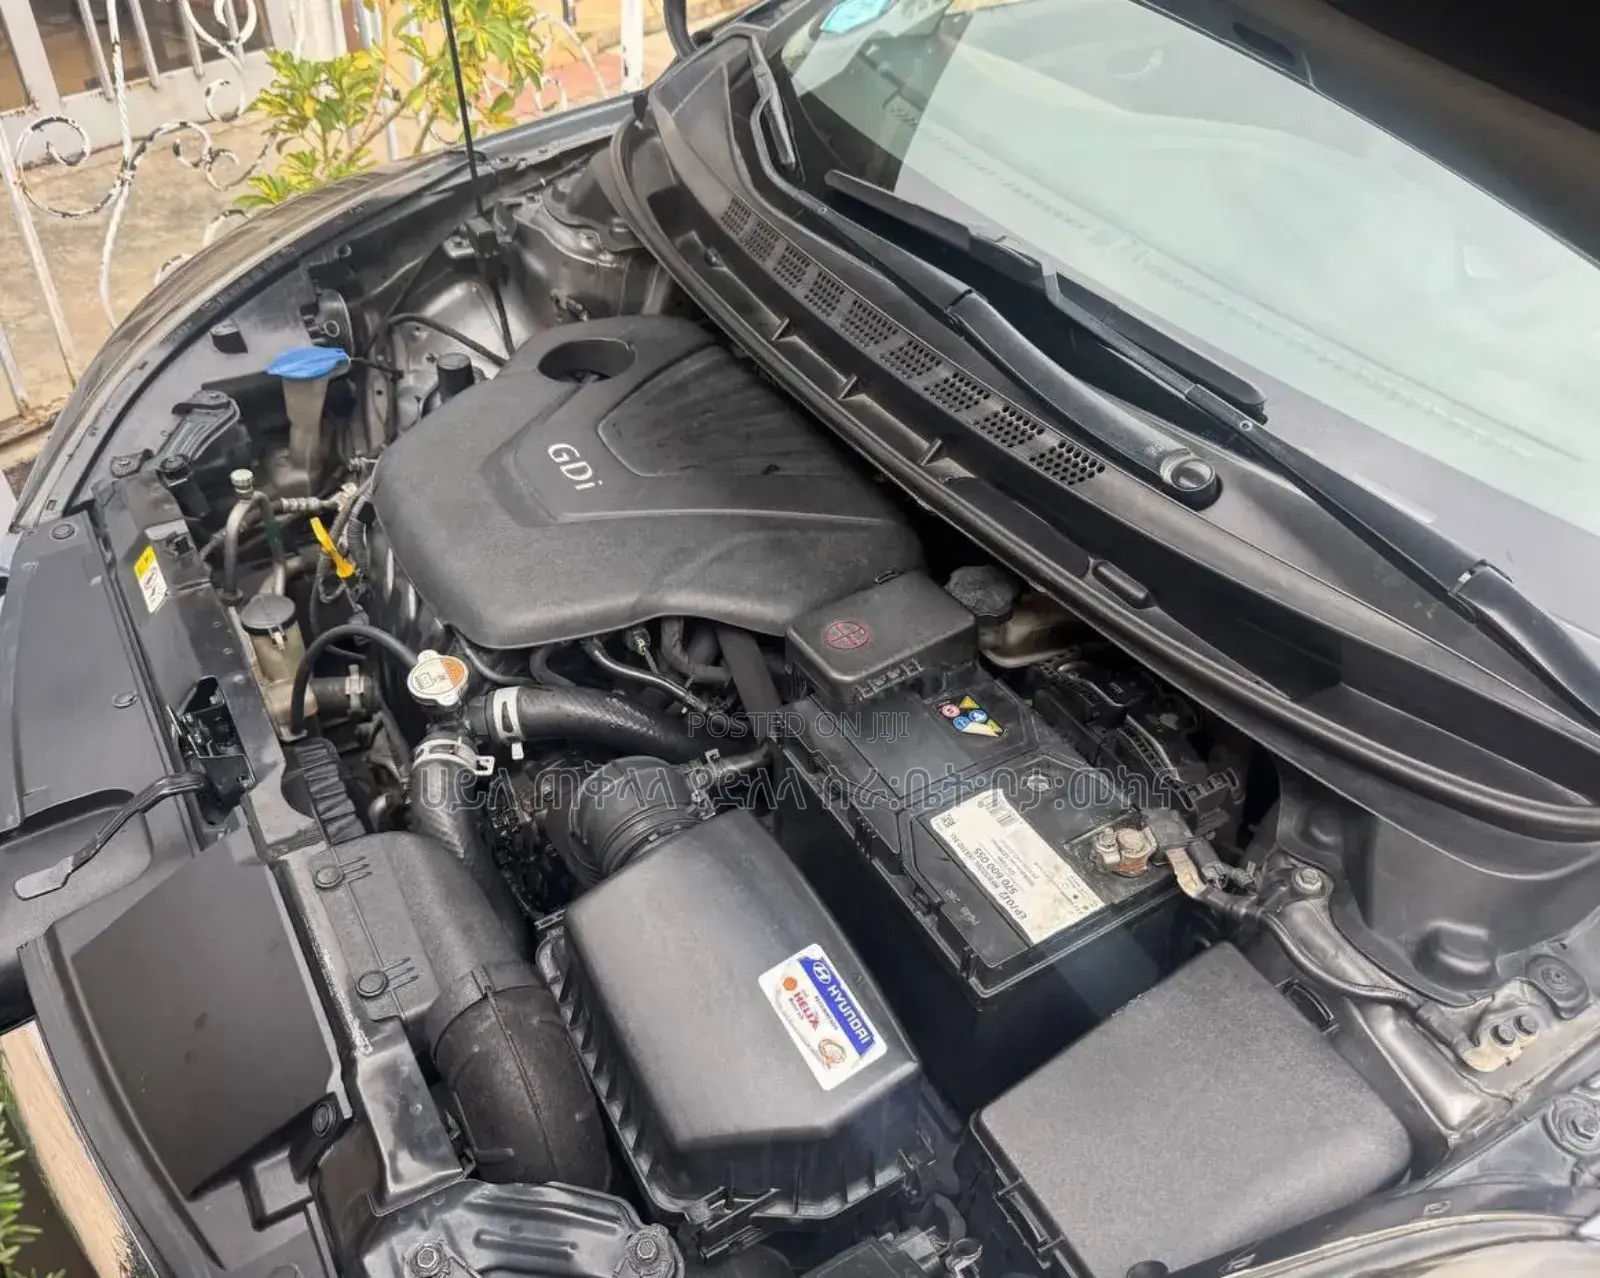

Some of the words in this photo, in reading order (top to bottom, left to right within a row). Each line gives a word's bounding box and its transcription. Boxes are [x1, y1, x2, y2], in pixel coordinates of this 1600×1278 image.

[547, 443, 603, 490] GDi
[793, 992, 820, 1031] HELIX
[827, 984, 872, 1044] HYUNDAI
